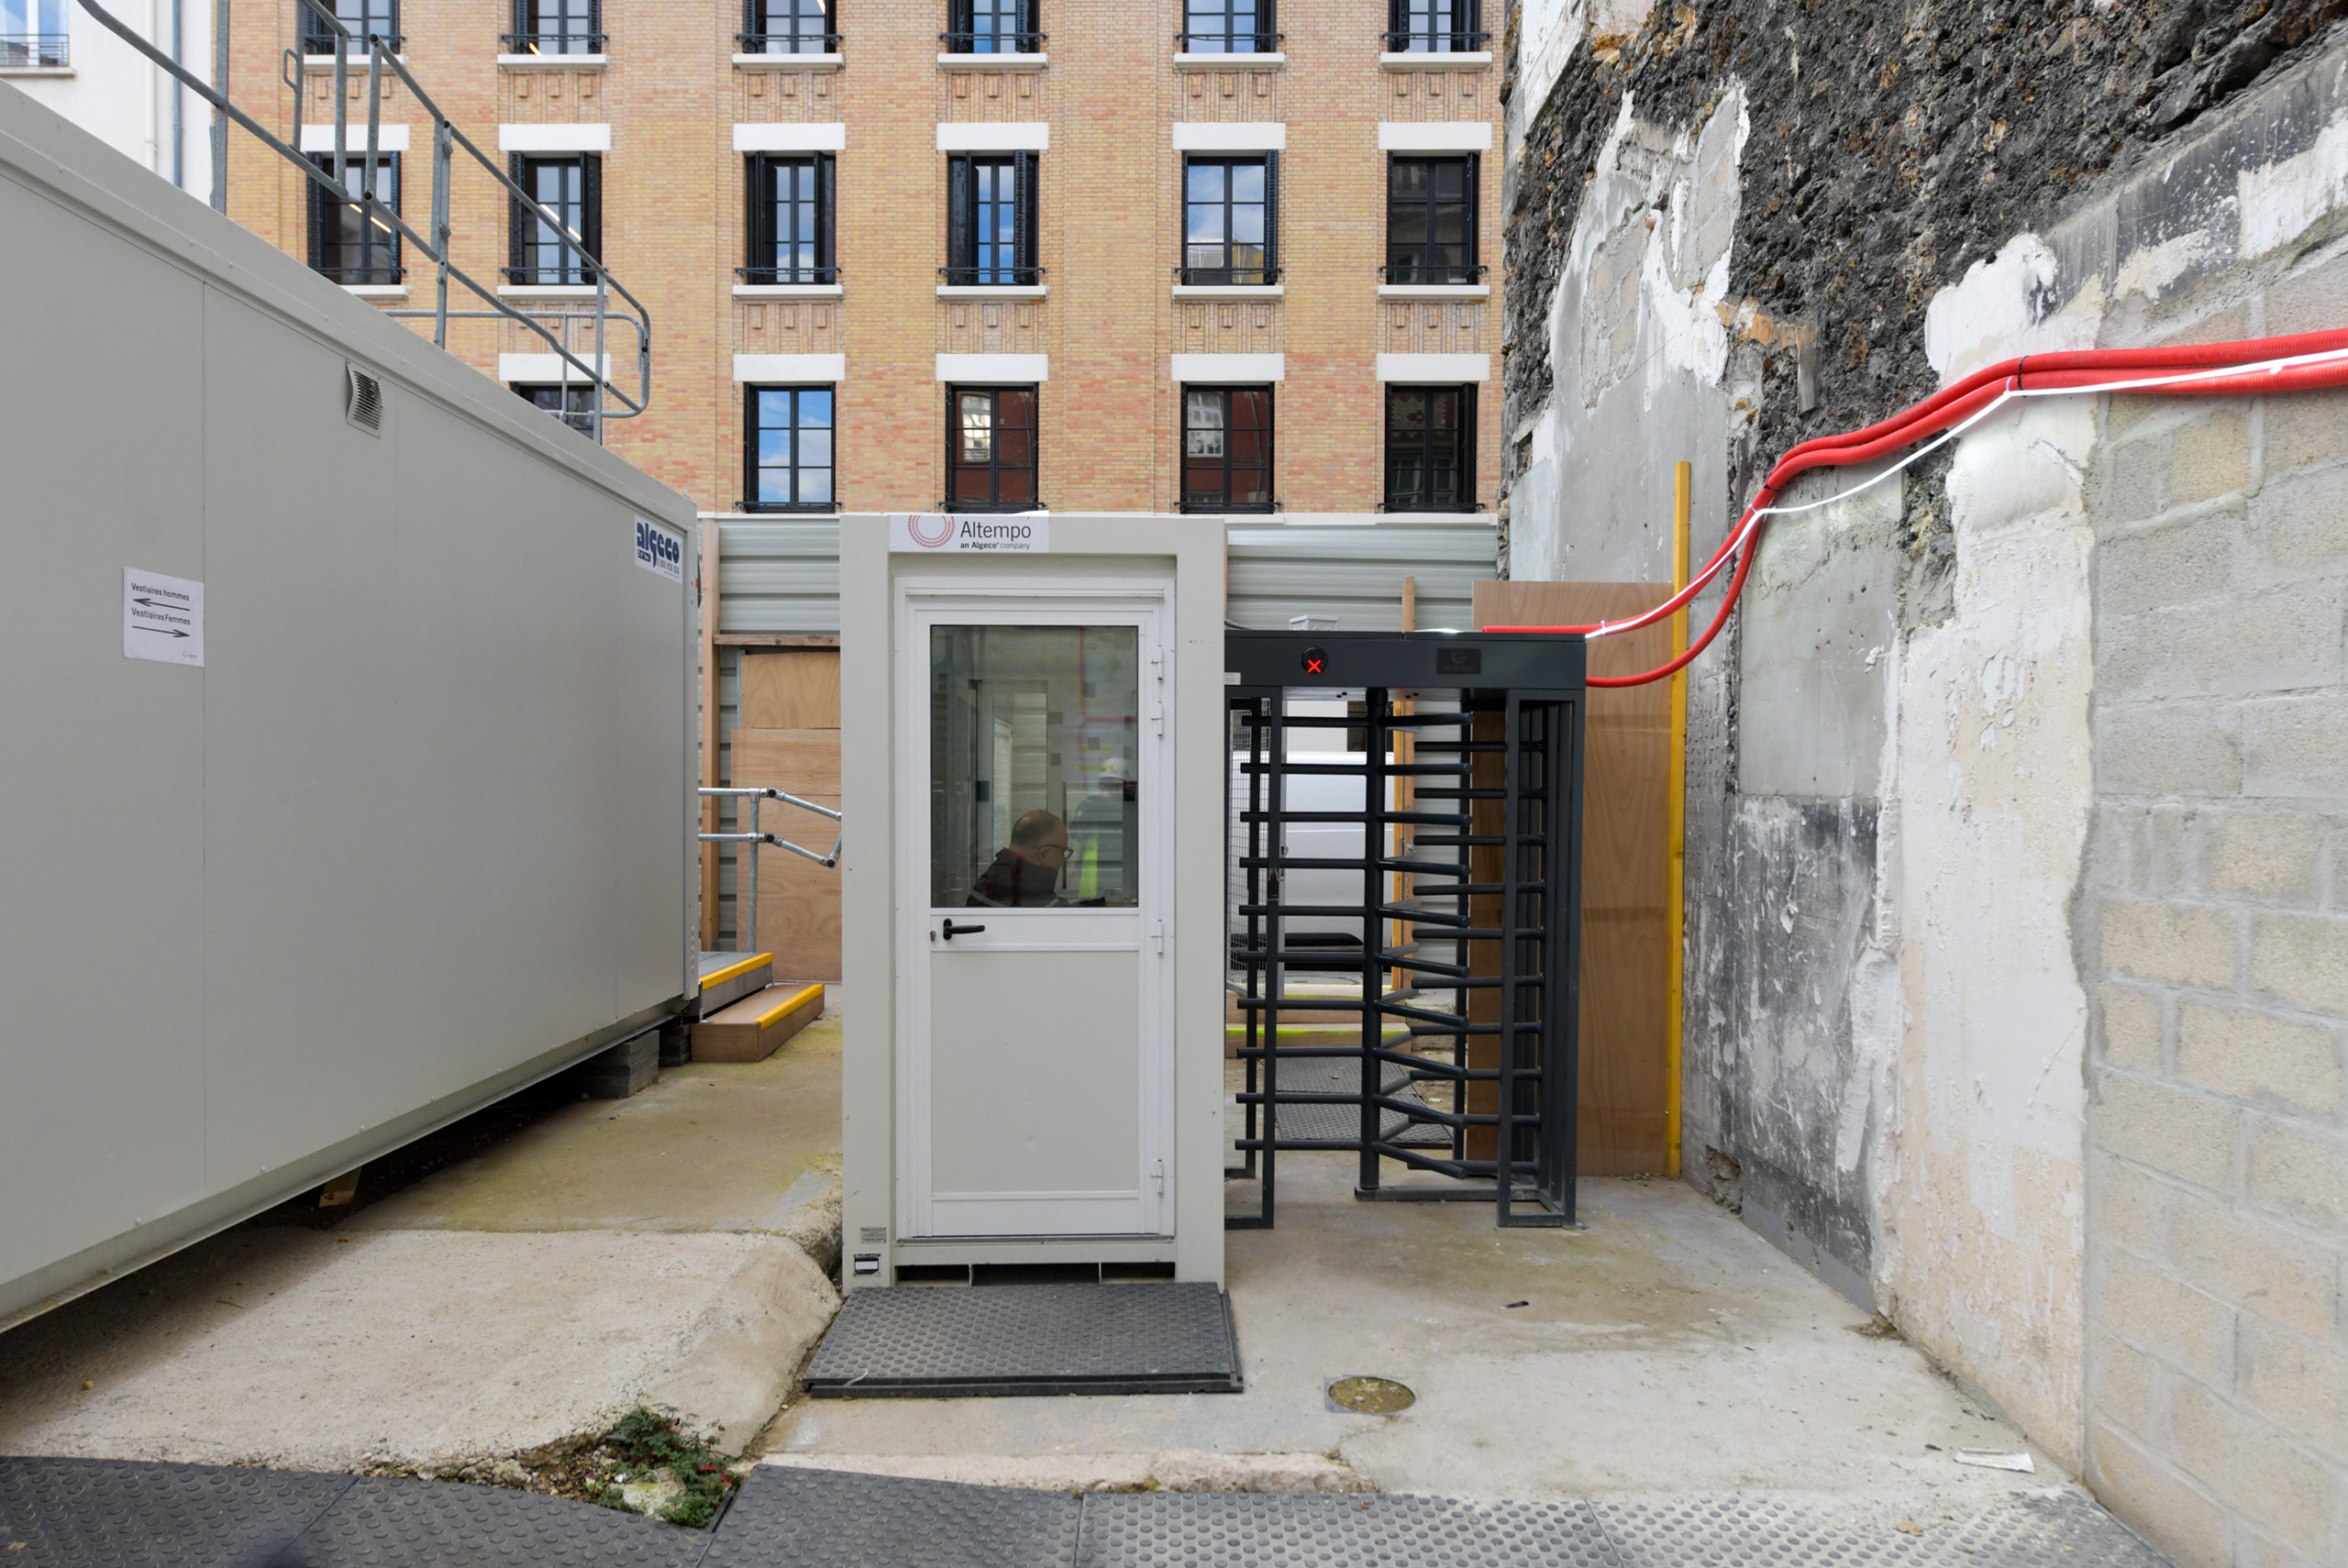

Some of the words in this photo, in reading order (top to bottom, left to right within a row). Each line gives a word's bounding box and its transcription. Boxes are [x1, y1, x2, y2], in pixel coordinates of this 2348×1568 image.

[960, 521, 1031, 541] Altempo
[637, 522, 680, 568] algeco
[131, 582, 162, 596] Vestiaires
[163, 589, 190, 602] hommes
[131, 607, 164, 621] Vestiaires
[165, 613, 191, 625] Femmes
